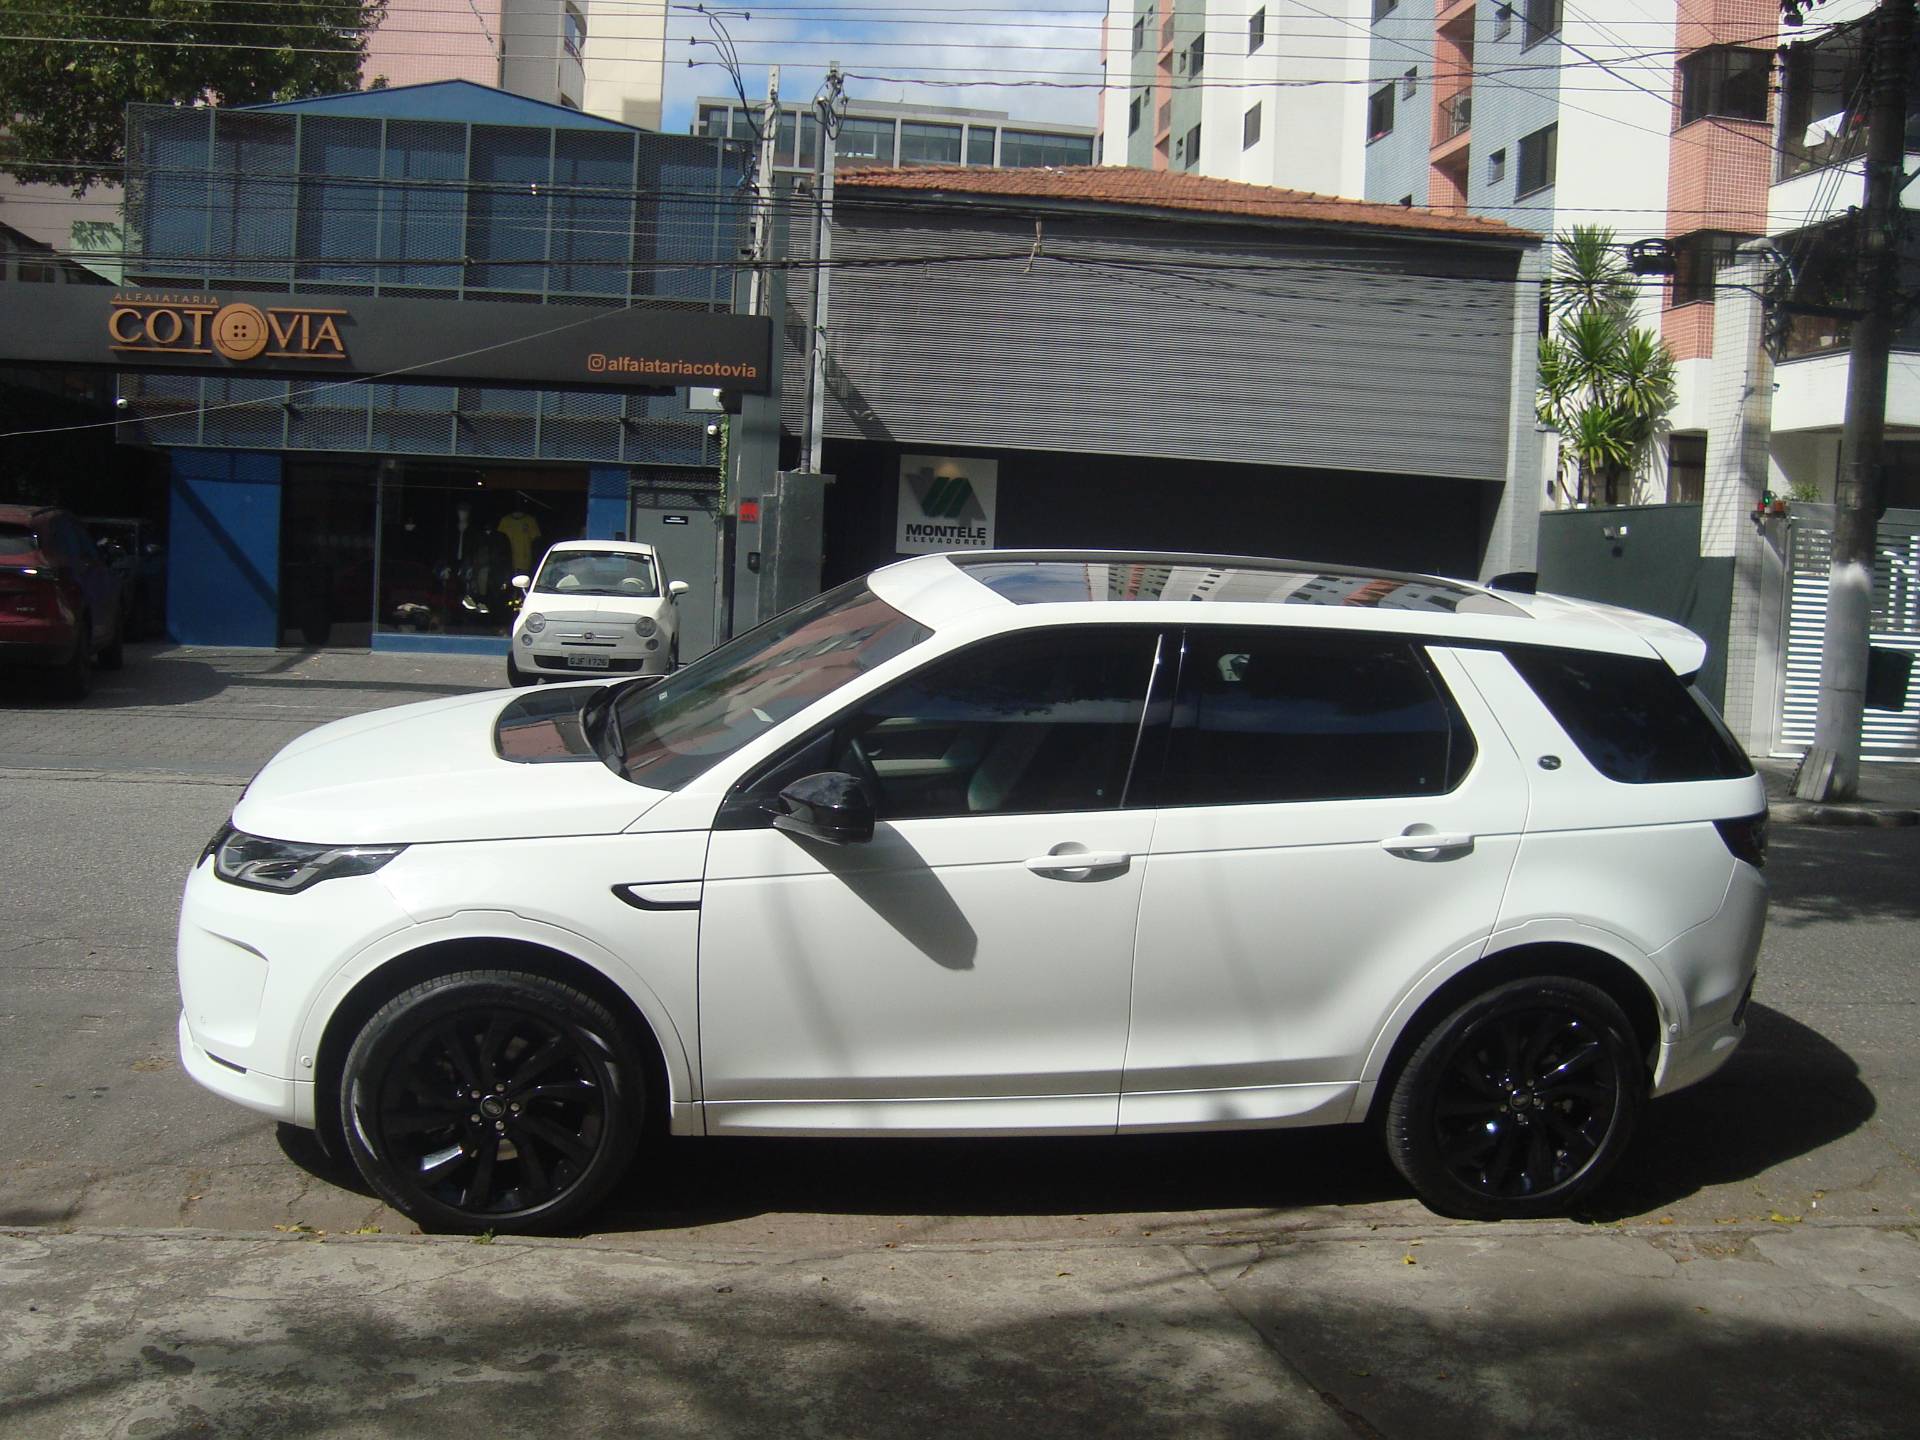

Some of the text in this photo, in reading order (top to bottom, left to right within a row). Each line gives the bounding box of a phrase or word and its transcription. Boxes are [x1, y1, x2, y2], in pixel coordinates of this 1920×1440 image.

[114, 292, 219, 304] ALFAIATARIA
[108, 303, 344, 360] COTOVIA
[607, 356, 757, 378] alfaiatariacotovia
[906, 524, 987, 539] MONTELE
[905, 536, 986, 546] ELEVADORES
